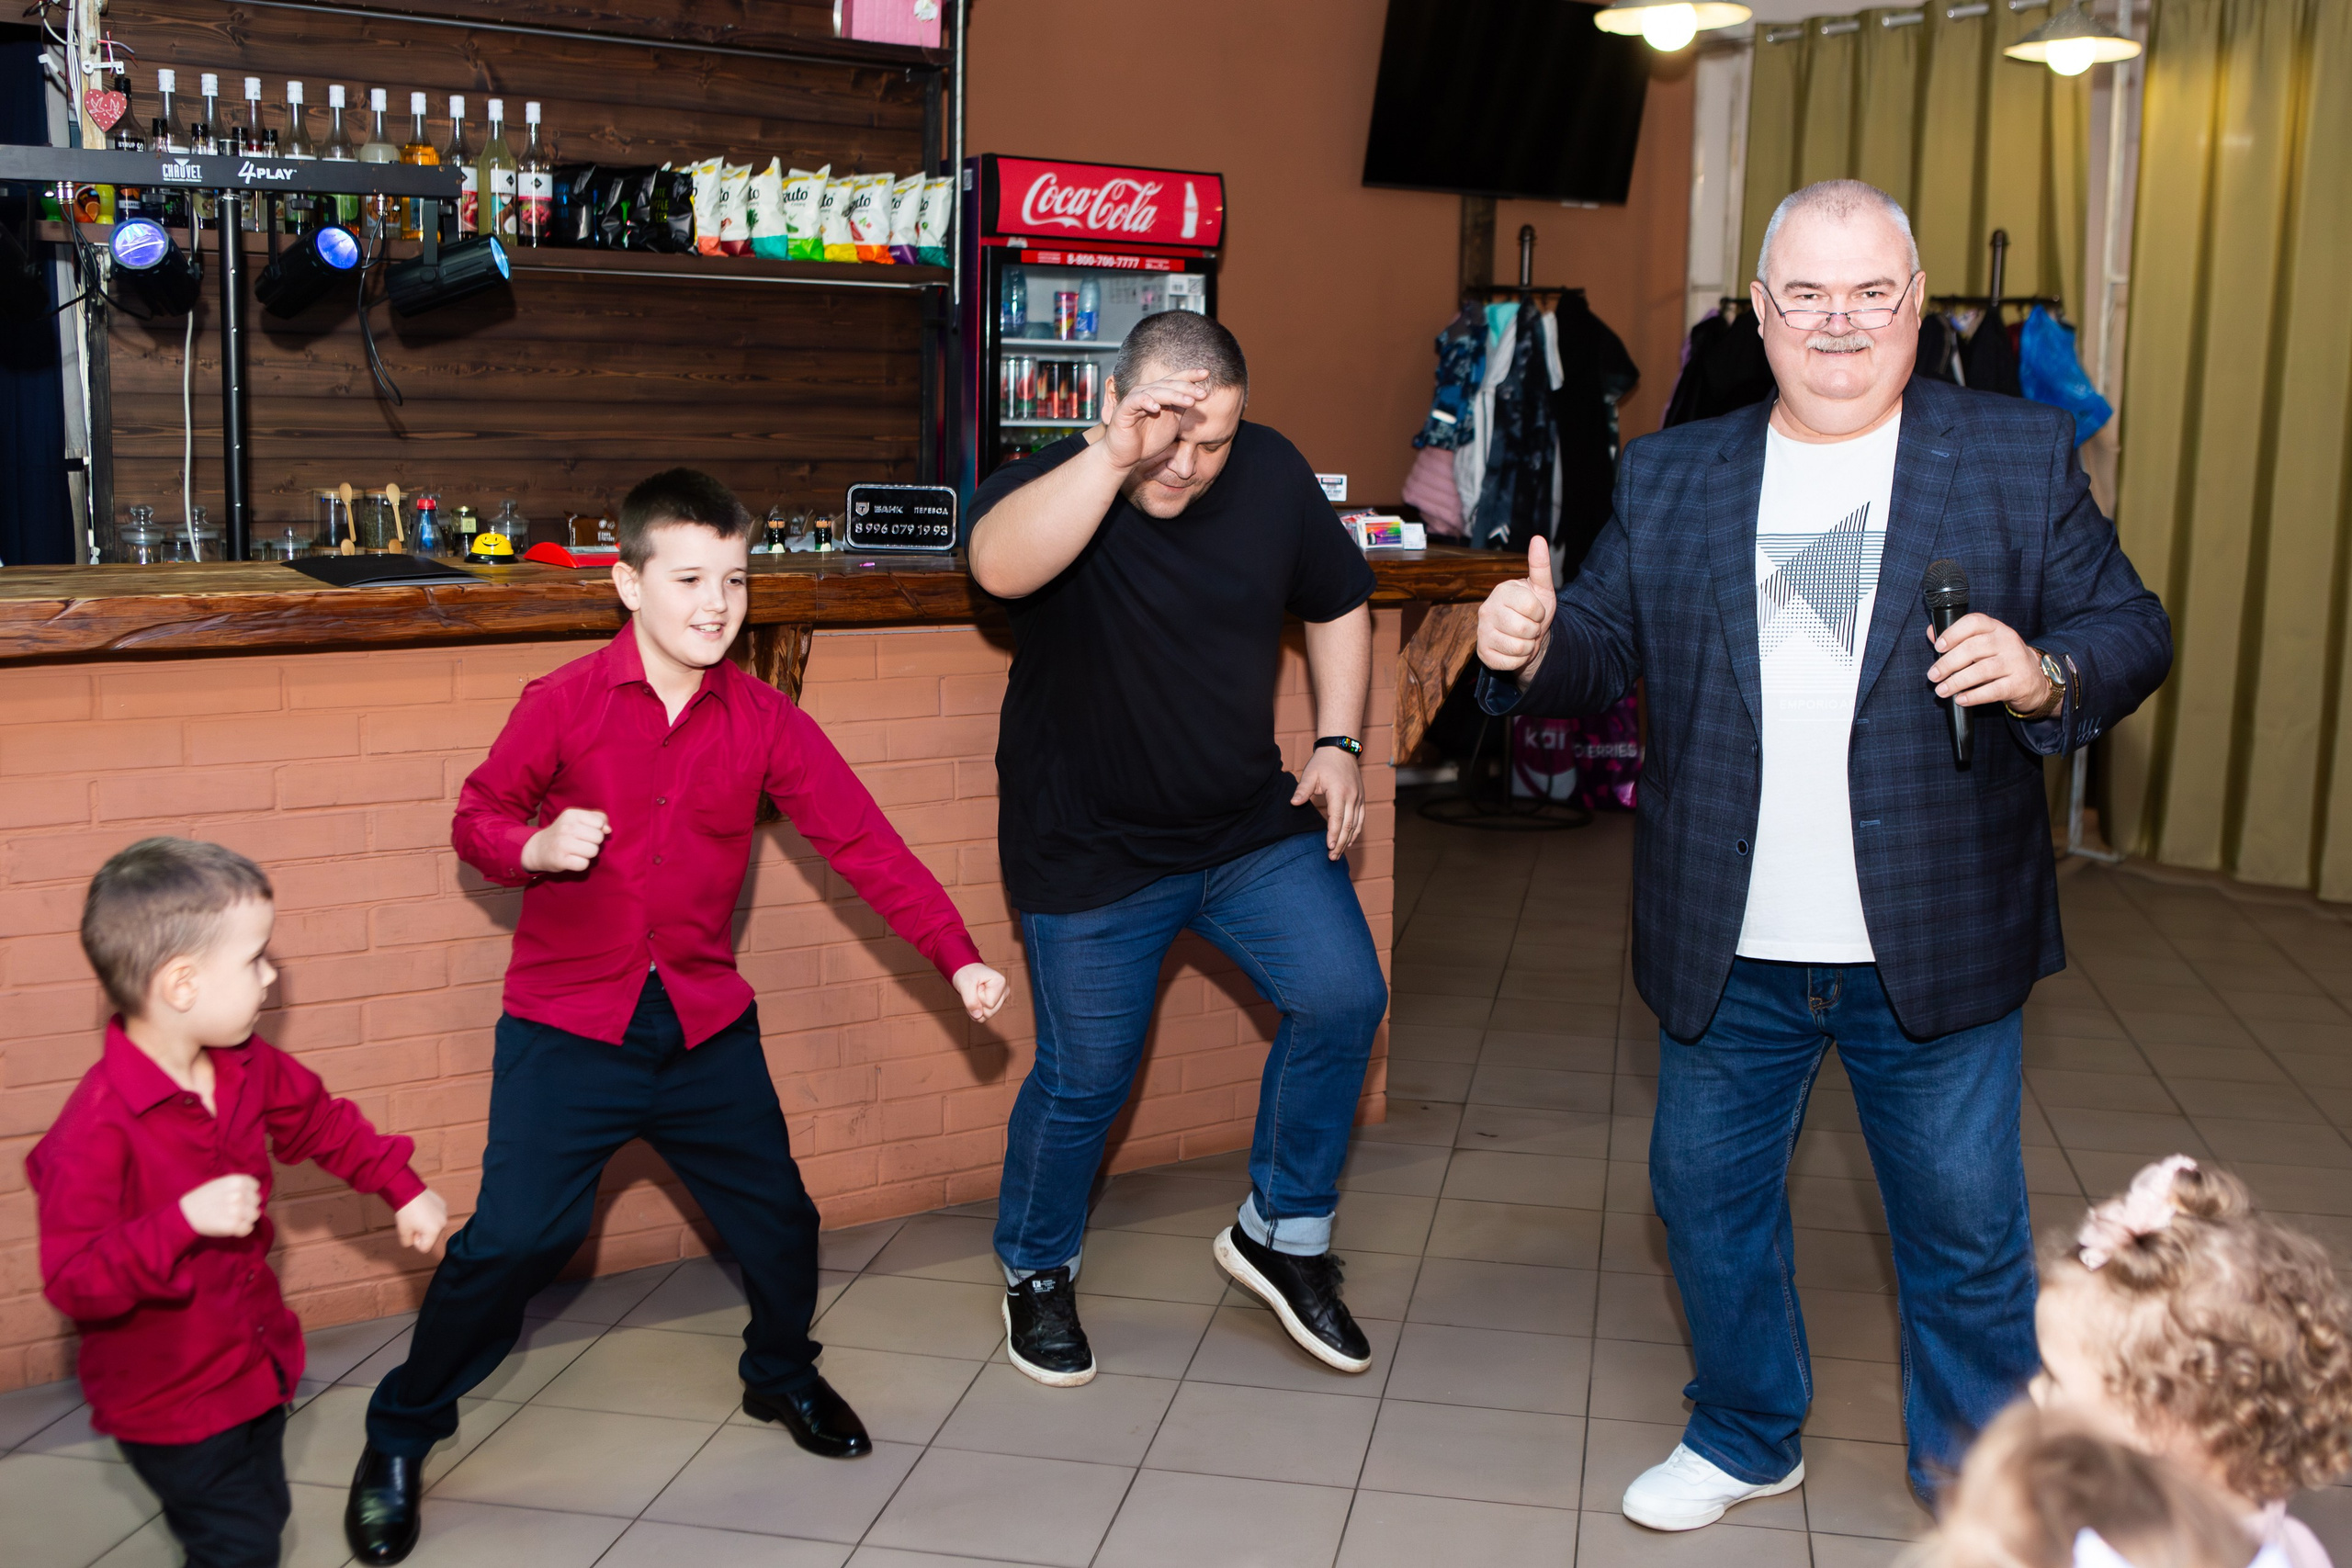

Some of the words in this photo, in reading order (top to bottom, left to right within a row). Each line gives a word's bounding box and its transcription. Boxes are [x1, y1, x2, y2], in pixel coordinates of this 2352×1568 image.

[162, 164, 202, 179] CHAUVET
[1023, 172, 1163, 234] Coca-Cola
[913, 506, 949, 515] ПЕРЕВОД
[854, 523, 863, 534] 8
[865, 523, 888, 535] 996
[891, 524, 915, 535] 079
